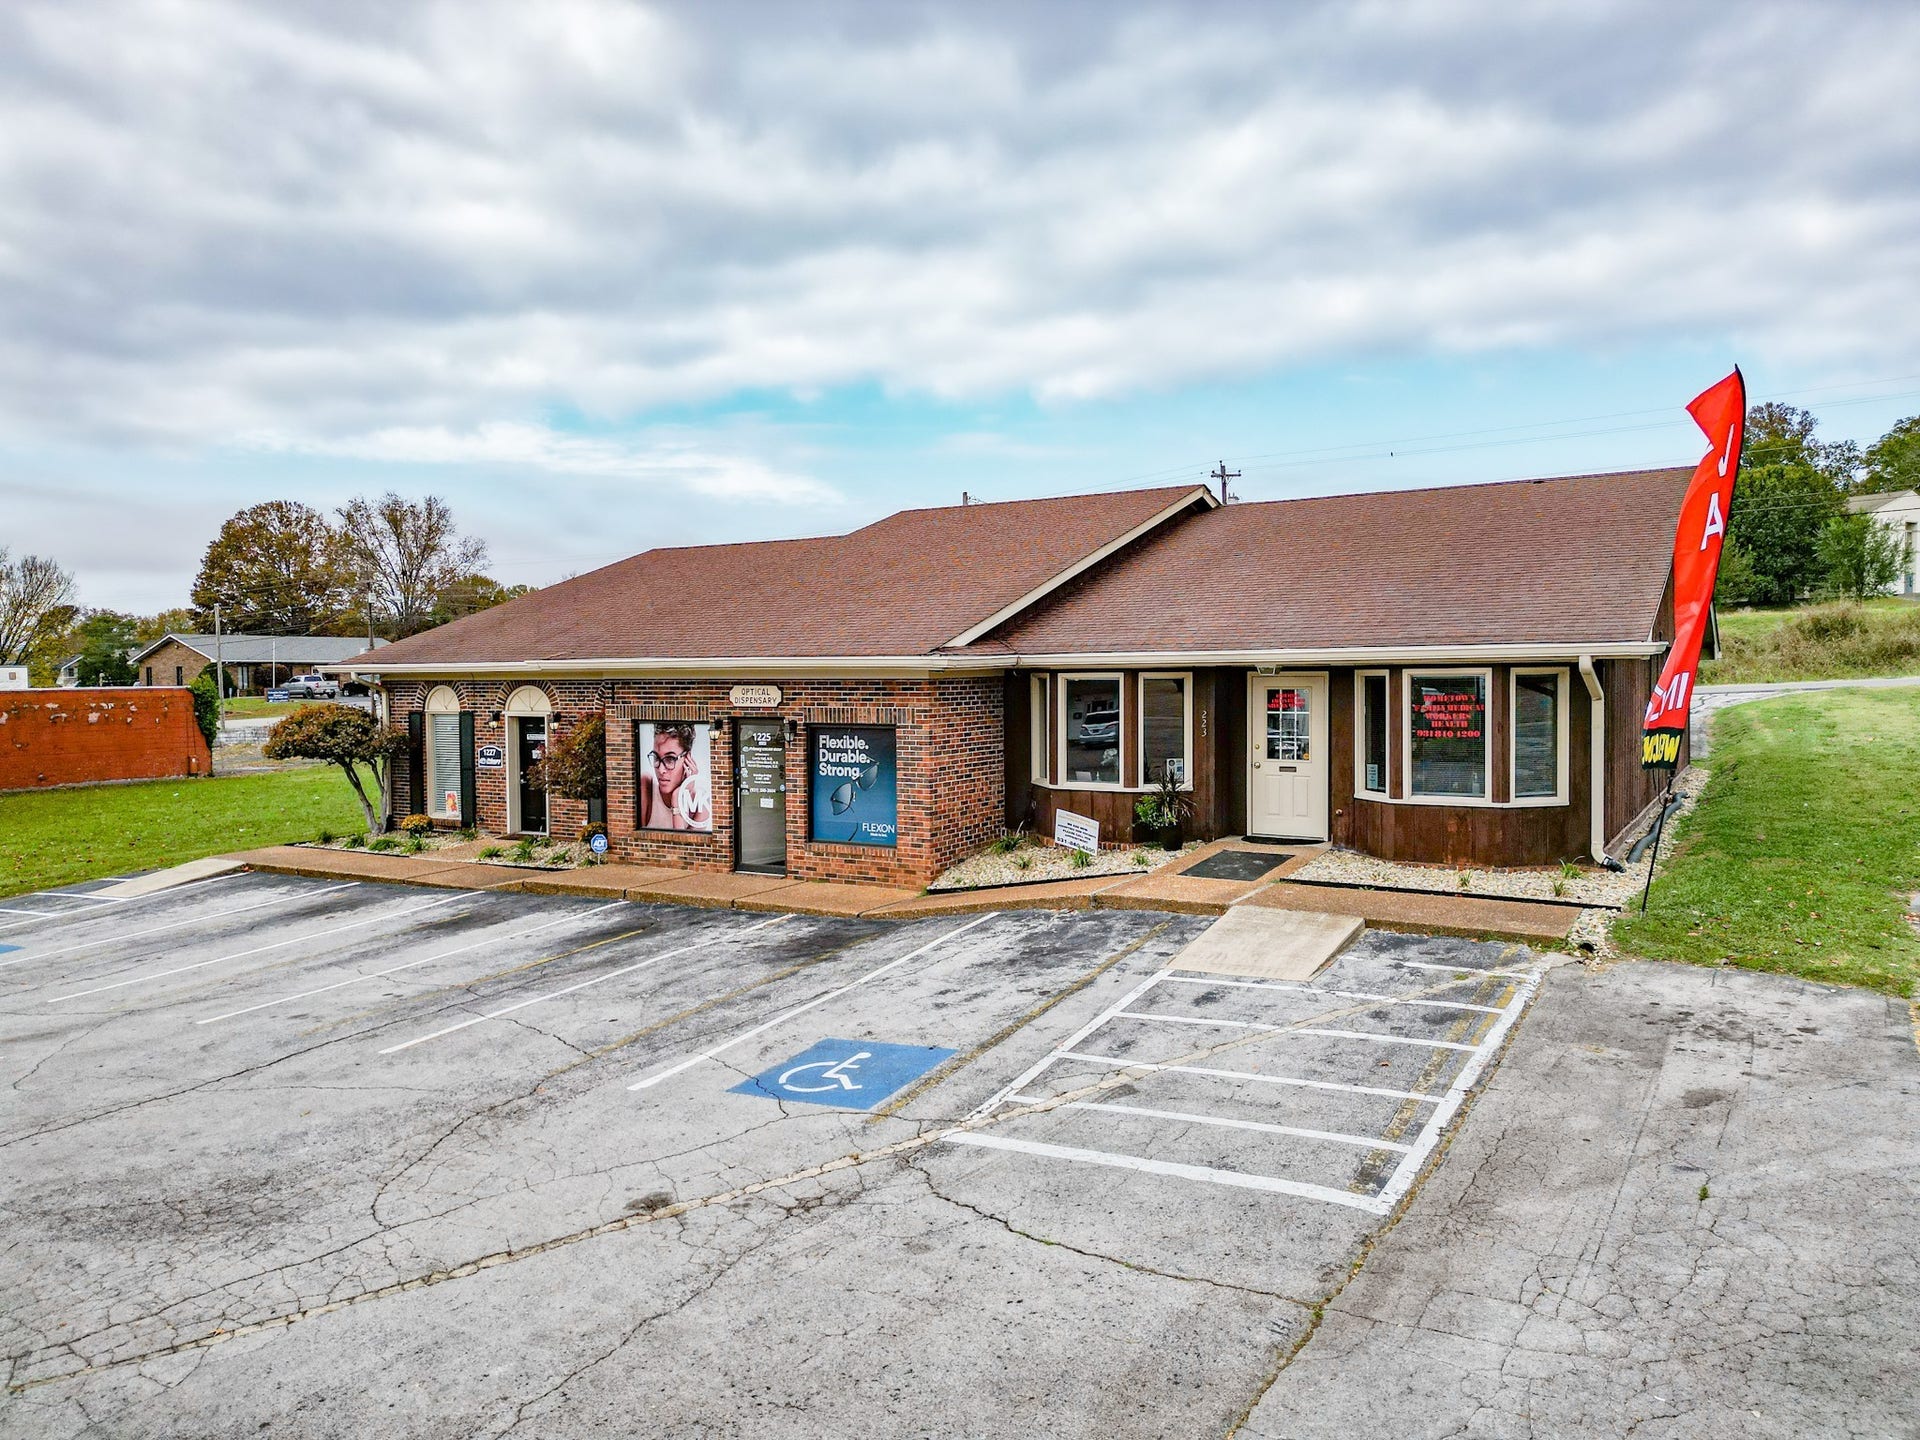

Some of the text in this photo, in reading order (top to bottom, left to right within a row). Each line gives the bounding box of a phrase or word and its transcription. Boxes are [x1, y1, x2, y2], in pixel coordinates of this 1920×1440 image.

[741, 688, 770, 696] OPTICAL
[734, 696, 777, 704] DISPENSARY
[1431, 720, 1468, 728] HEALTH
[753, 732, 772, 742] 1225
[819, 734, 869, 750] Flexible.
[819, 748, 871, 764] Durable.
[818, 762, 864, 780] Strong.
[862, 822, 895, 834] FLEXON
